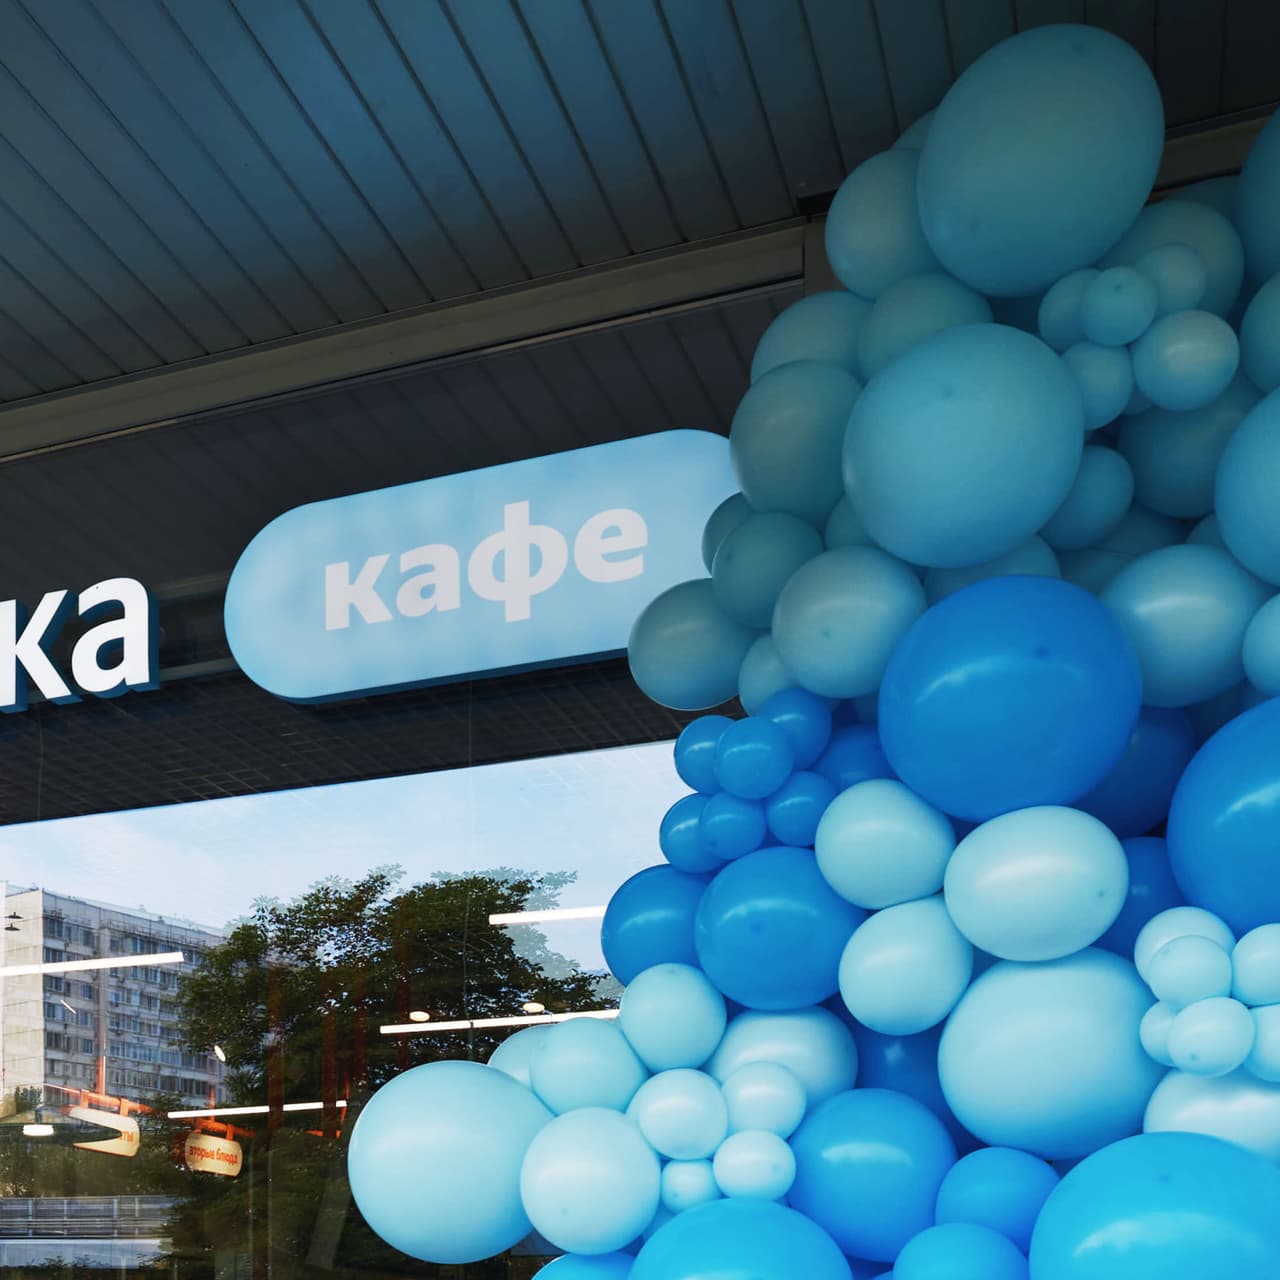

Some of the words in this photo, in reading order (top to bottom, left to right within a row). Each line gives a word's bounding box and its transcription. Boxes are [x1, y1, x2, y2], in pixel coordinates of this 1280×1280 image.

[324, 499, 649, 632] кафе
[189, 1146, 215, 1161] вторые
[215, 1147, 238, 1165] блюда
